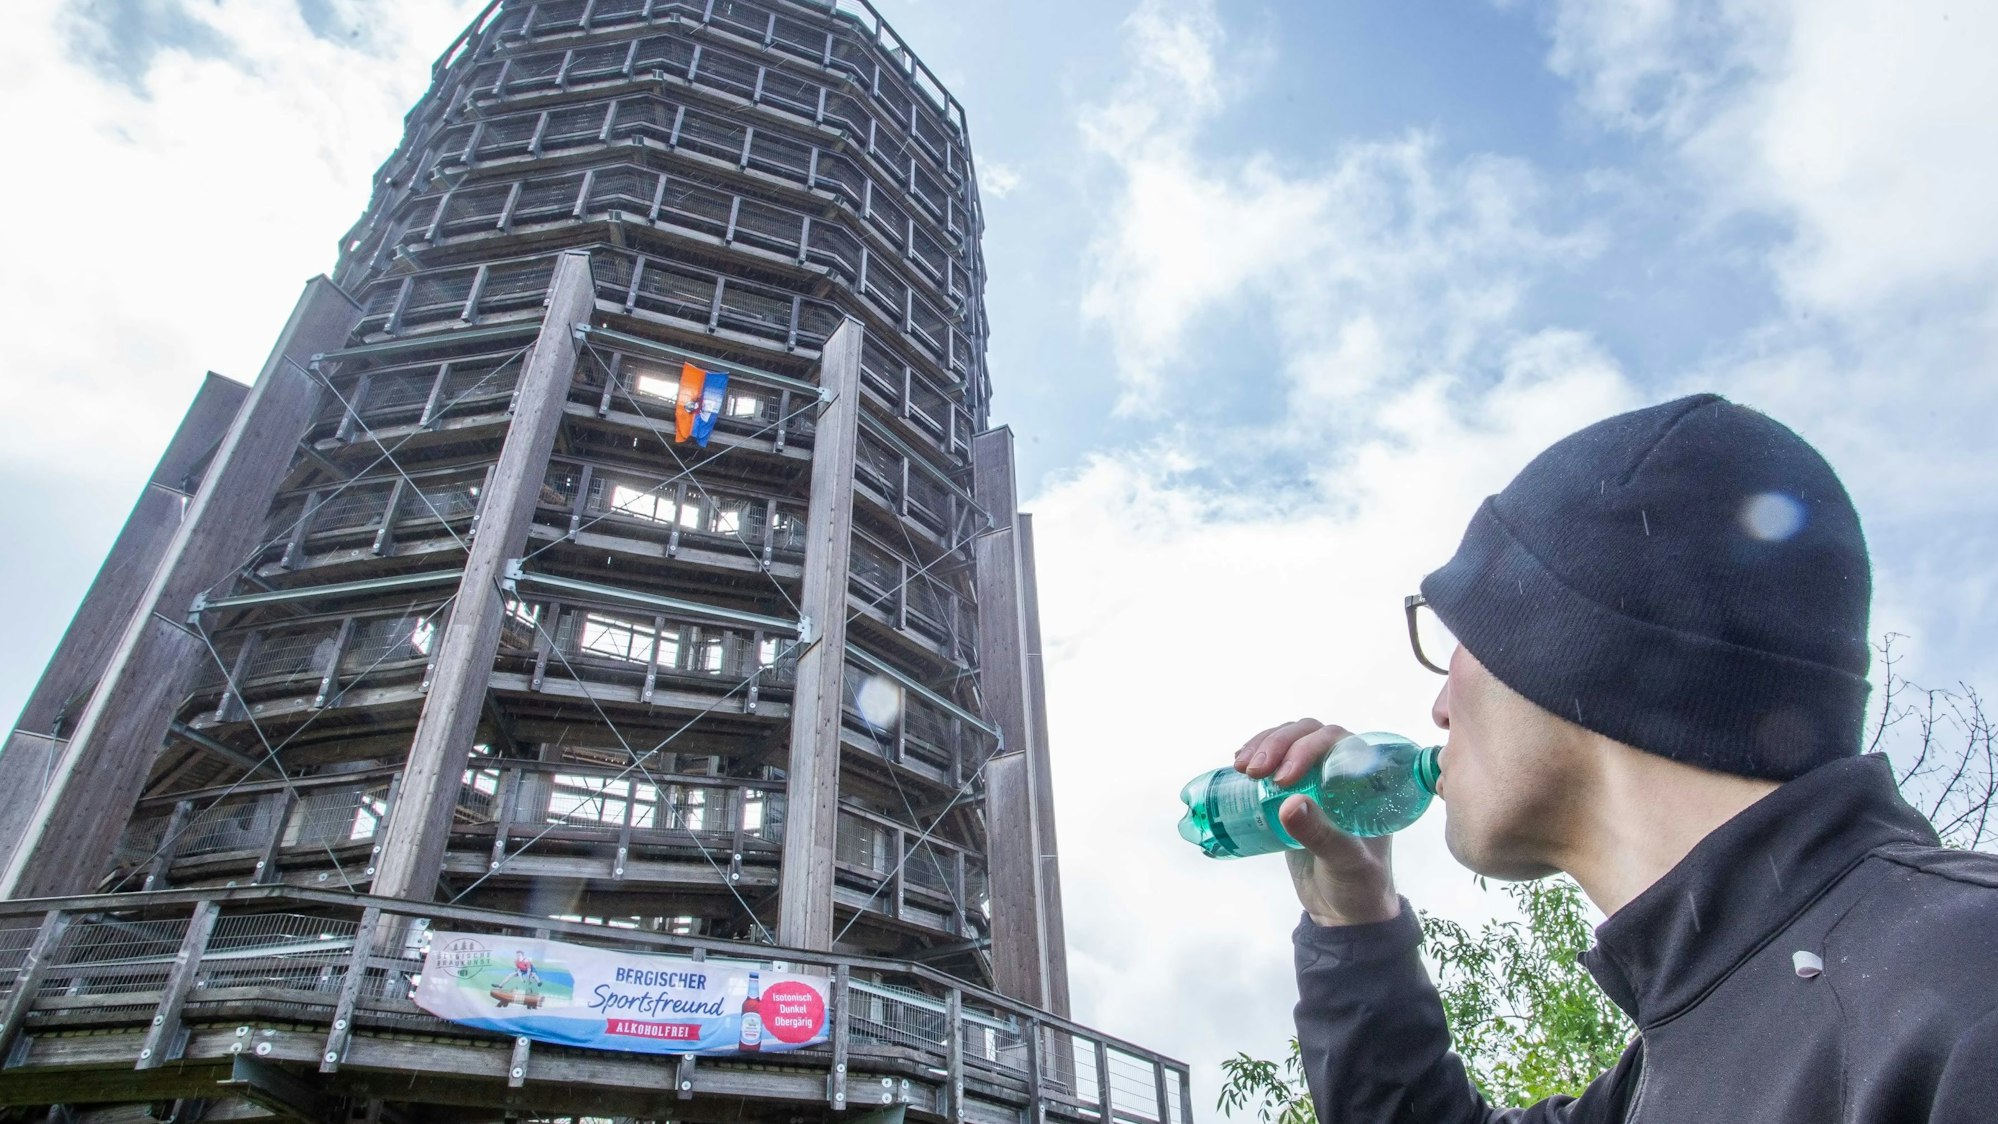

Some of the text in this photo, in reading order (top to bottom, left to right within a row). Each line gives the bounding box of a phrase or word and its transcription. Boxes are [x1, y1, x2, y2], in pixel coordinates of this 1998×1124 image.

[616, 967, 707, 990] BERGISCHER
[588, 984, 725, 1018] Sportsfreund
[773, 993, 812, 1002] Isotonisch
[780, 1004, 807, 1014] Dunkel
[775, 1016, 813, 1029] Obergärig
[616, 1022, 689, 1038] ALKOHOLFREI
